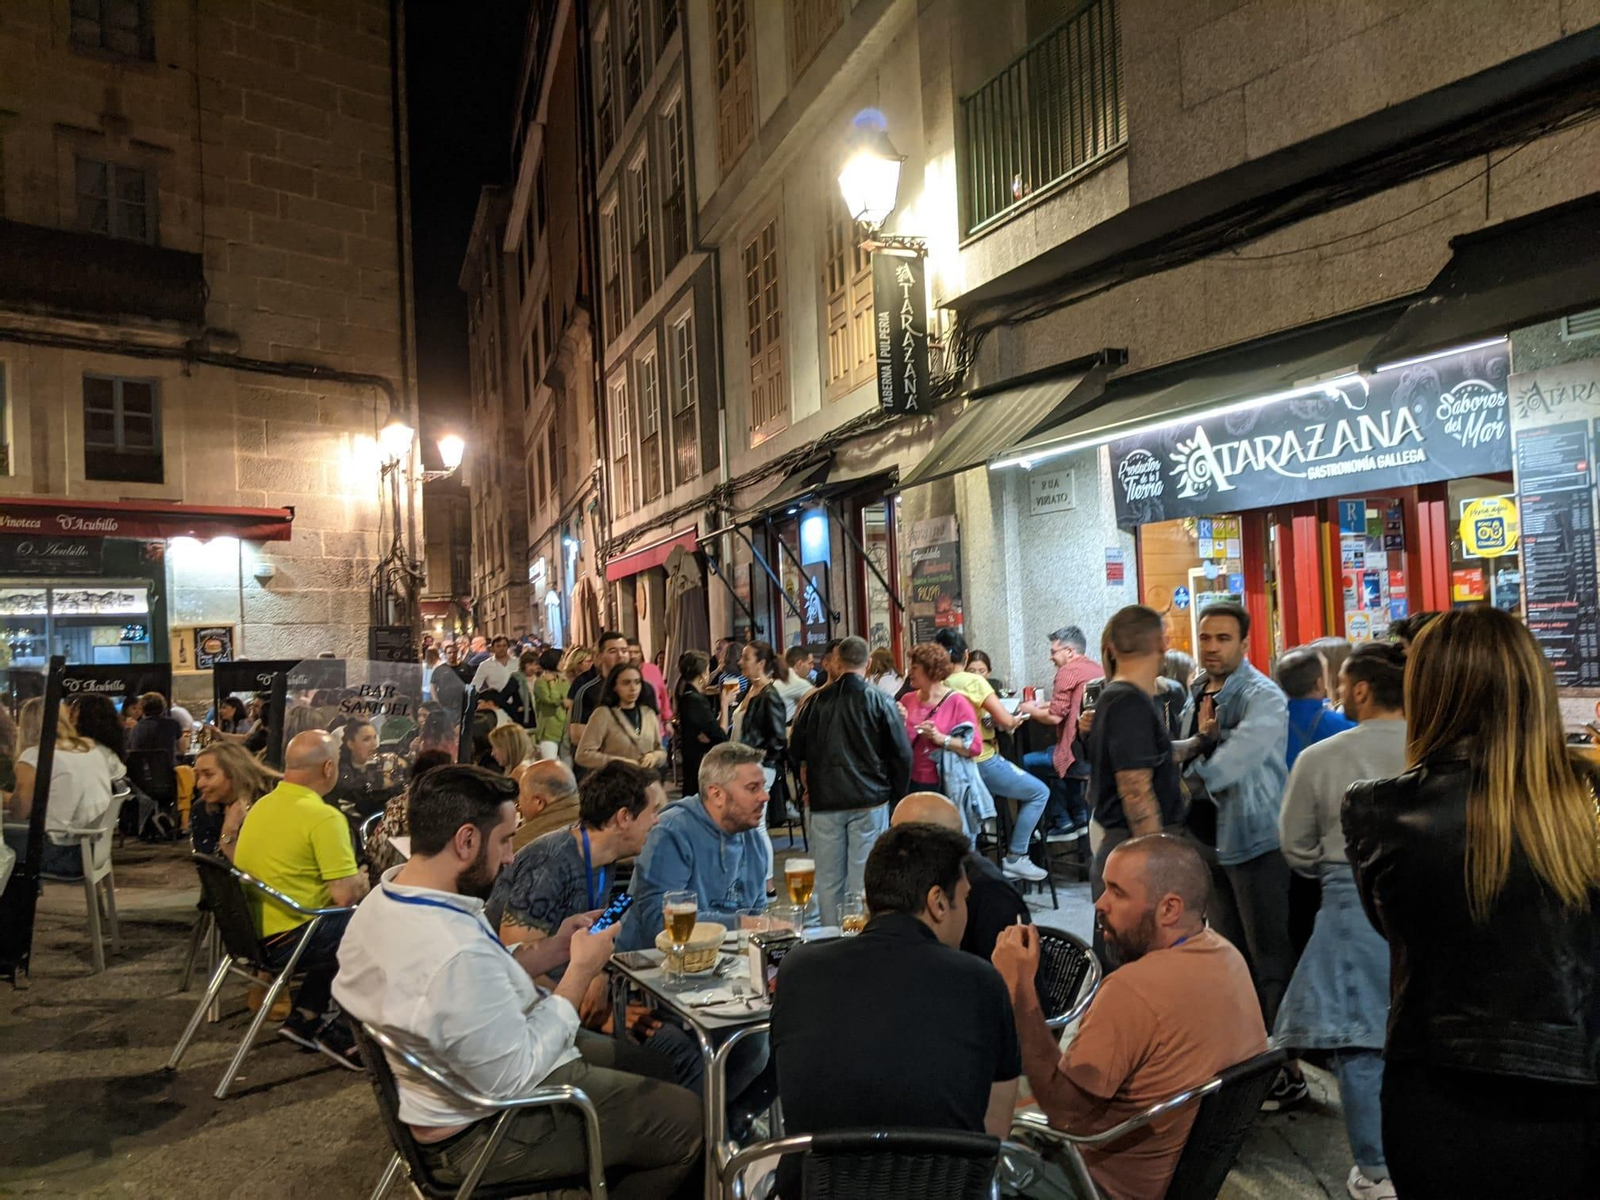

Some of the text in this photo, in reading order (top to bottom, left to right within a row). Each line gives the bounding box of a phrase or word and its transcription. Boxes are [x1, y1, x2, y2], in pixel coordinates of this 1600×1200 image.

[895, 262, 923, 410] ATARAZANA
[879, 311, 894, 408] TABERNA PULPERIA
[1436, 391, 1508, 420] Sabores
[1444, 416, 1462, 433] del
[1461, 410, 1507, 448] Mar
[1118, 455, 1162, 478] Productos
[1169, 406, 1426, 499] ATARAZANA
[1307, 448, 1426, 480] GASTRONOMÍA GALLEGA
[1125, 475, 1165, 504] Tierra
[1140, 474, 1148, 484] de
[1036, 493, 1068, 506] VIRIATO
[0, 515, 42, 529] Vinoteca
[358, 684, 397, 698] BAR
[338, 700, 411, 717] SAMUEL
